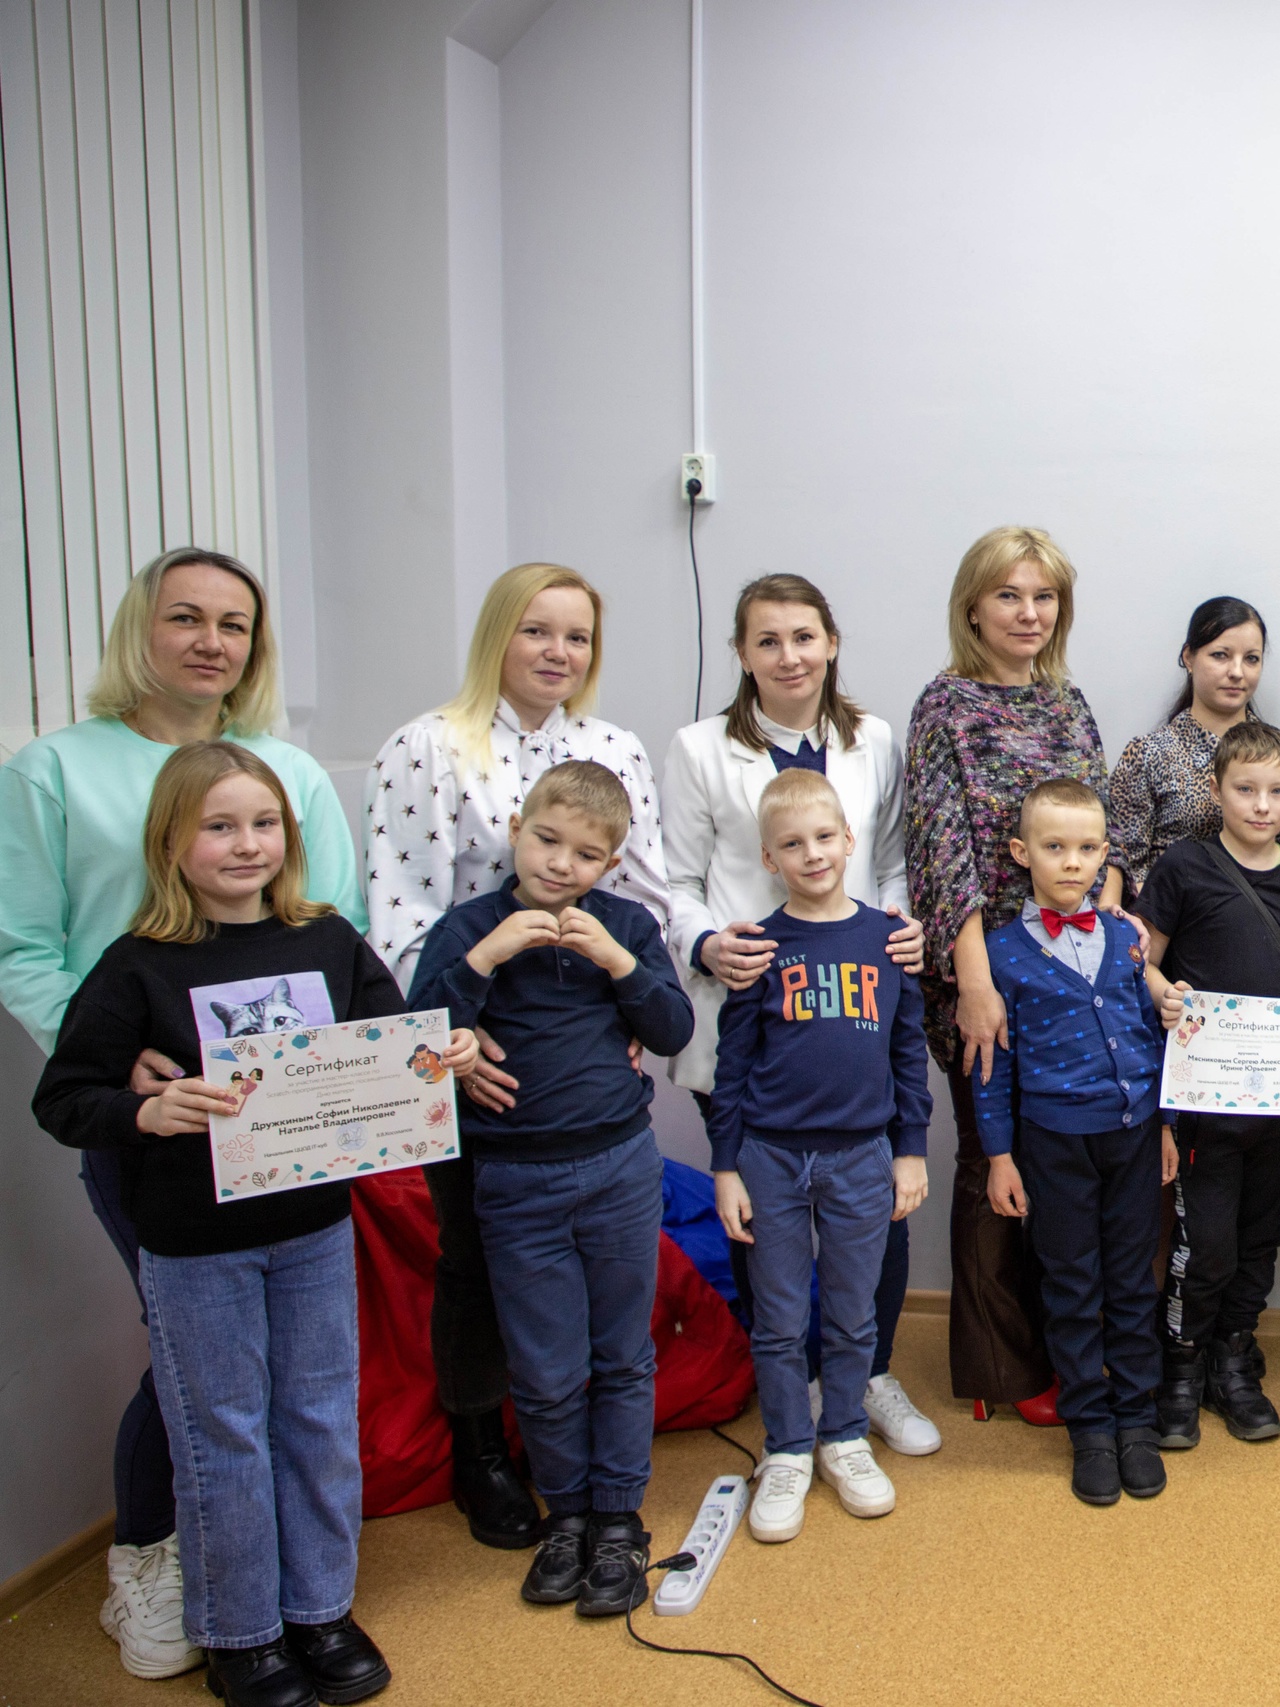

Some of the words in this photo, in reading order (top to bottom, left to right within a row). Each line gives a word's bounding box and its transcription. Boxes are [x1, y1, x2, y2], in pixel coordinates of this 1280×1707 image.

[778, 954, 806, 968] BEST
[781, 962, 879, 1023] PLAYER
[855, 1020, 879, 1032] EVER
[1218, 1018, 1280, 1032] Сертификат
[284, 1055, 378, 1077] Сертификат
[1187, 1054, 1232, 1063] Мясниковым
[1232, 1057, 1259, 1066] Сергею
[1244, 1065, 1277, 1073] Юрьевне
[320, 1098, 351, 1107] вручается
[250, 1115, 314, 1132] Дружкиным
[315, 1109, 350, 1120] Софии
[352, 1098, 411, 1113] Николаевне
[278, 1123, 320, 1136] Наталье
[322, 1110, 396, 1128] Владимировне
